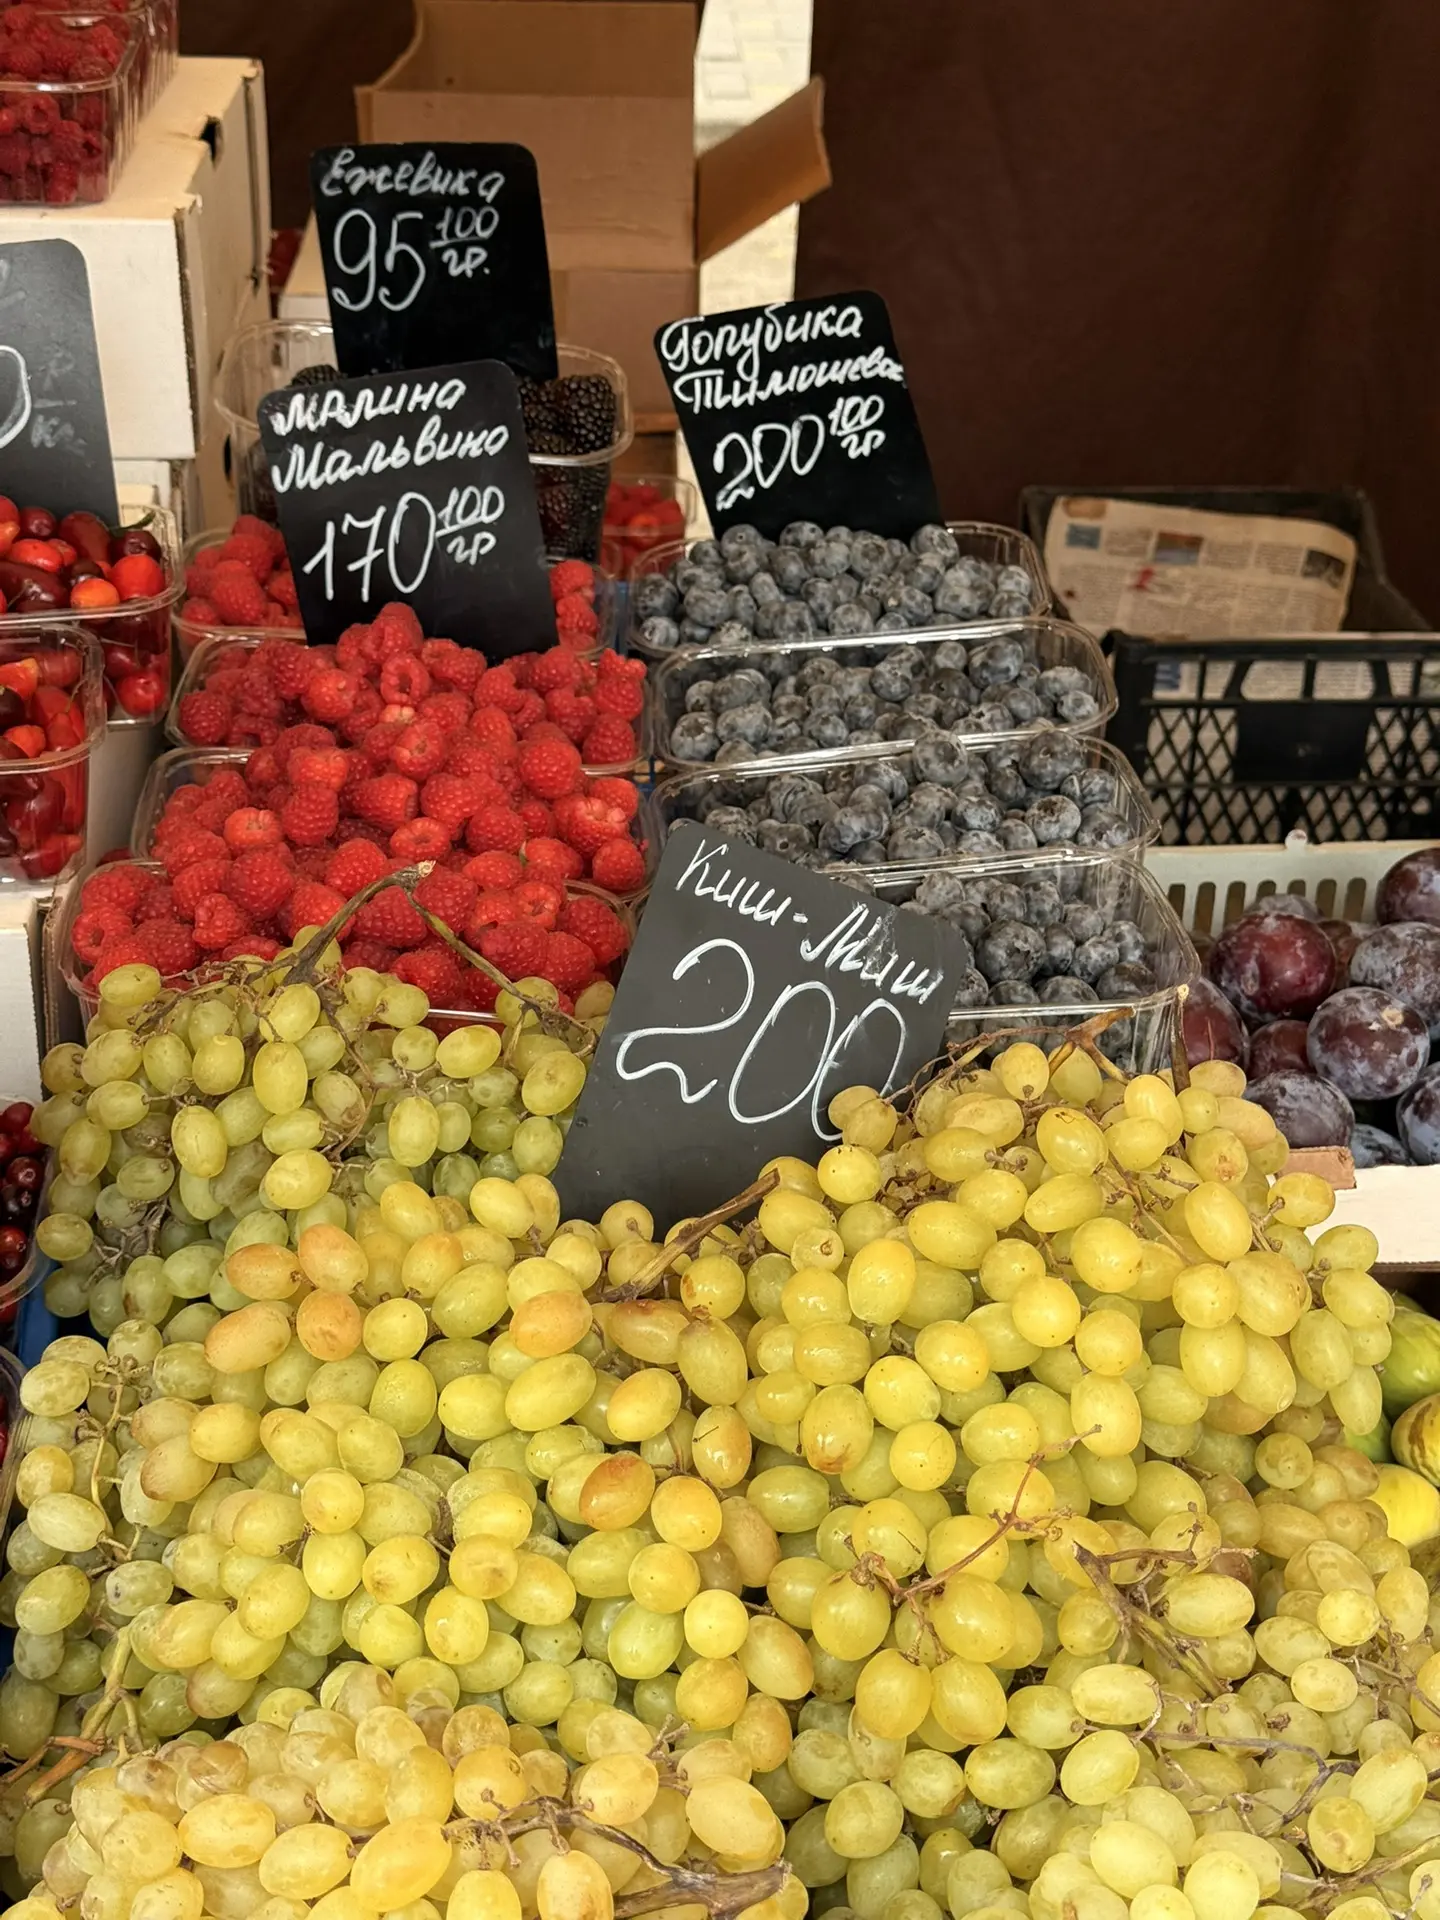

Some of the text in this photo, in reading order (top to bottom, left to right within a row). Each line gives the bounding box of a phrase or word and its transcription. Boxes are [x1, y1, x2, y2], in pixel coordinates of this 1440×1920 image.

[320, 149, 505, 203] Ежевика
[331, 206, 499, 311] 95 100
[660, 302, 864, 382] Голубика
[713, 394, 885, 512] 200 100
[302, 485, 505, 602] 170 100
[616, 938, 908, 1142] 200
